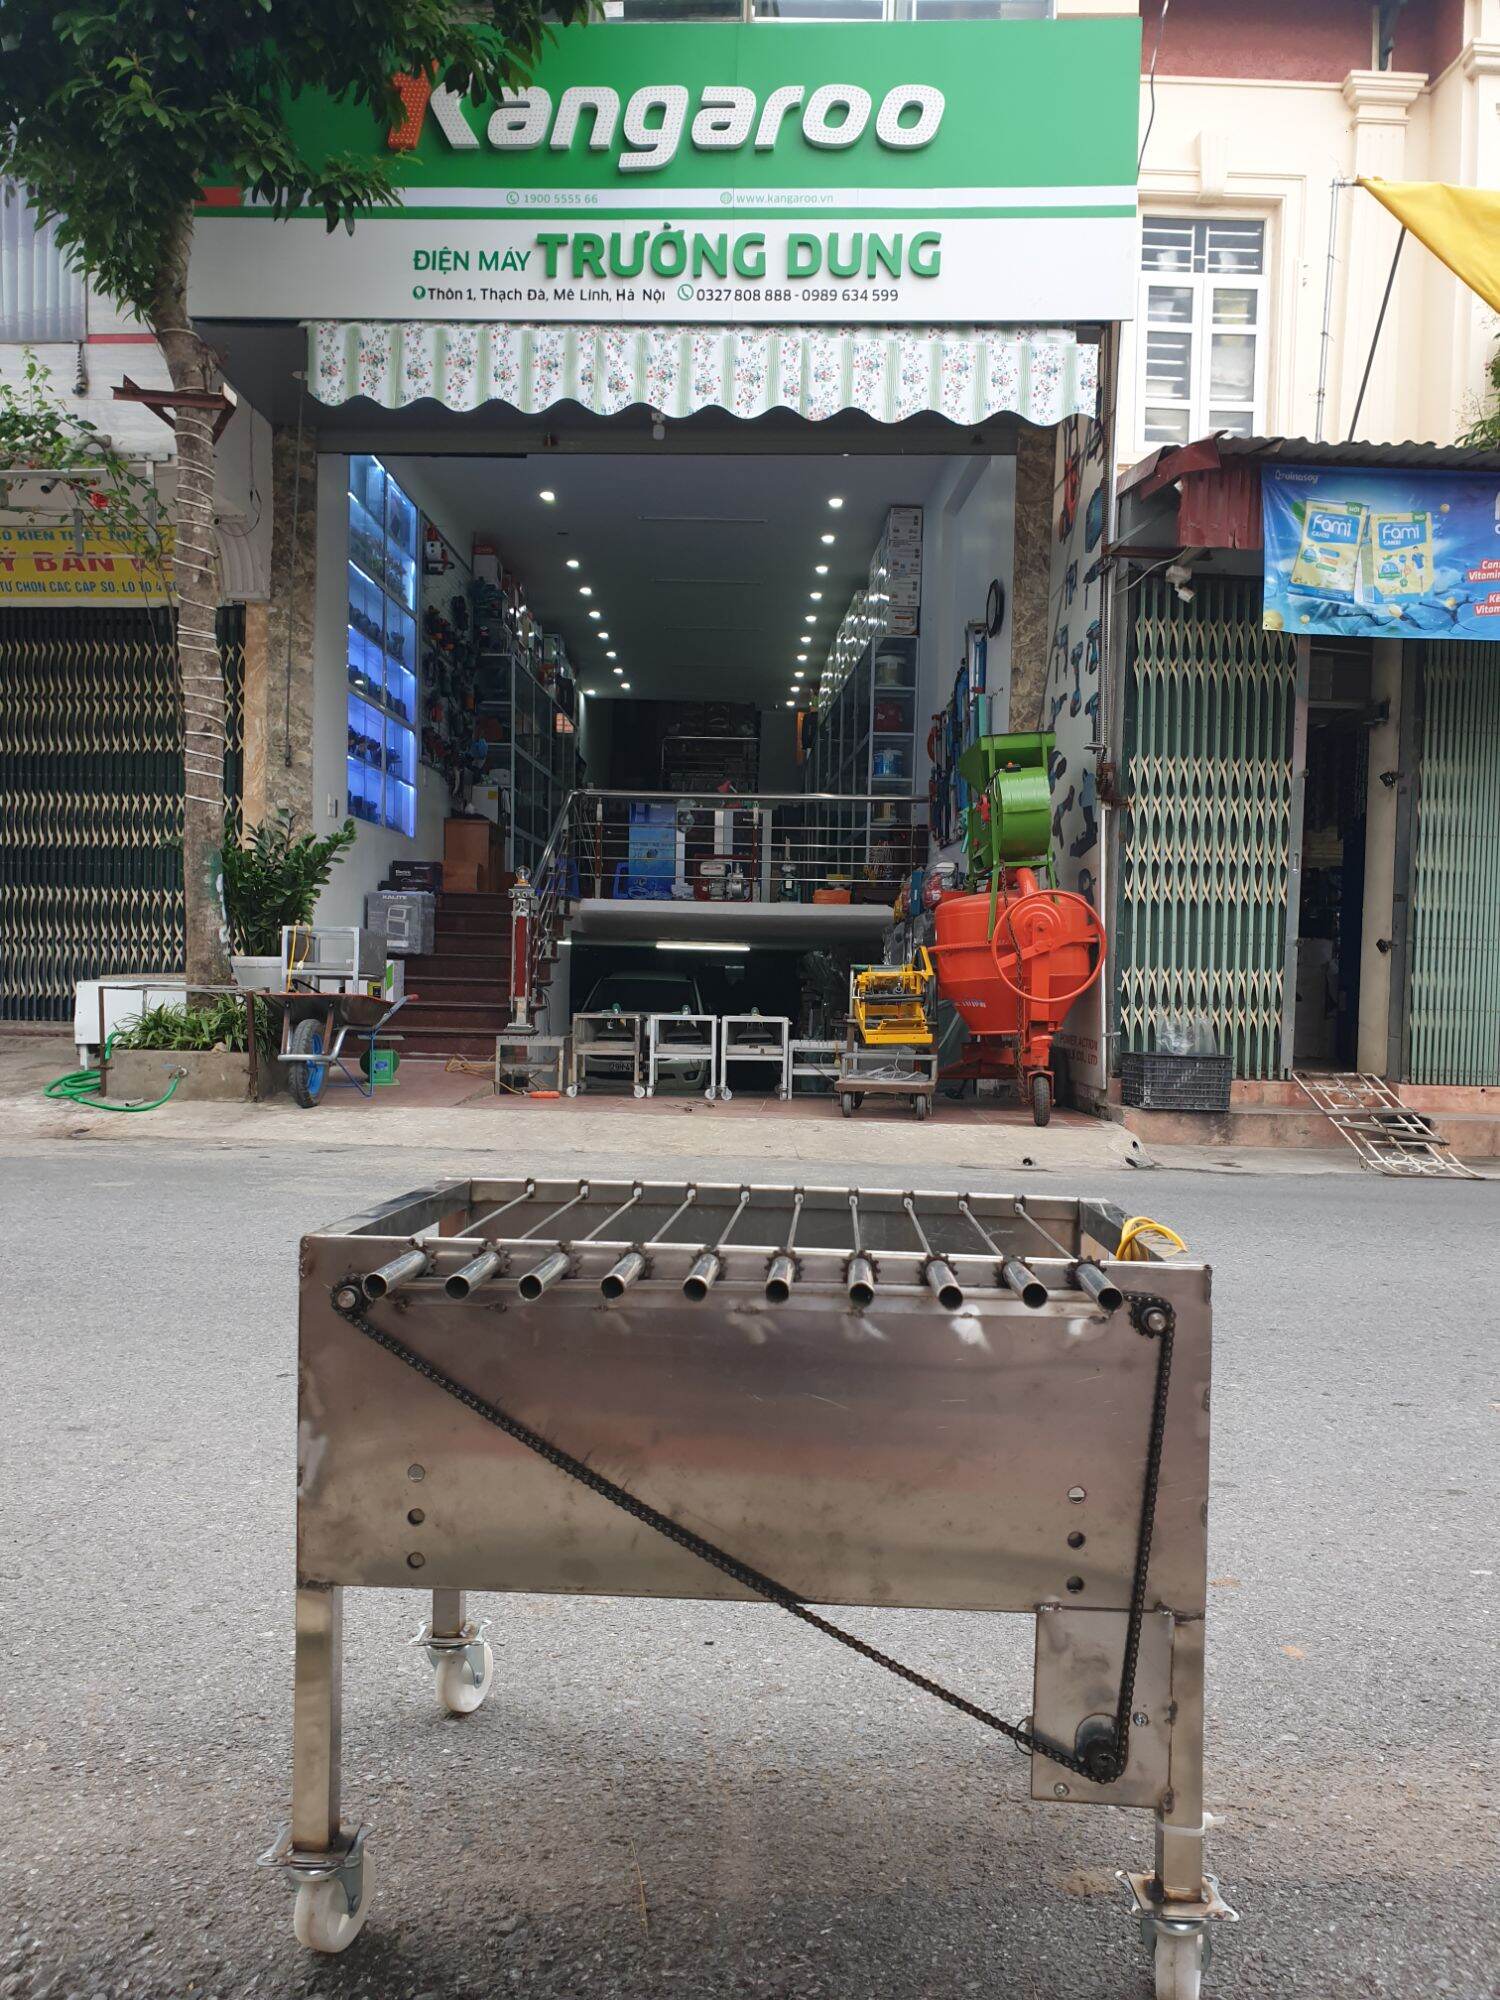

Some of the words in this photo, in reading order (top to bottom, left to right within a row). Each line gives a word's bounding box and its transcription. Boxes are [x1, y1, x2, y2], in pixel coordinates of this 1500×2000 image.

[388, 58, 946, 172] Kangaroo
[524, 194, 550, 204] 1900
[554, 194, 581, 204] 5555
[584, 194, 598, 204] 66
[736, 193, 834, 205] www.kangaroo.vn
[412, 246, 470, 275] ĐIỆN
[478, 246, 532, 272] MÁY
[787, 231, 942, 279] DUNG
[428, 287, 463, 301] Thôn
[466, 288, 477, 302] 1,
[480, 287, 523, 304] Thạch
[553, 288, 577, 301] Mê
[579, 288, 612, 303] Linh,
[642, 288, 667, 304] Nội
[696, 288, 732, 302] 0327
[734, 288, 761, 302] 808
[764, 288, 792, 302] 888
[802, 288, 838, 302] 0989
[841, 288, 869, 302] 634
[872, 288, 899, 302] 599
